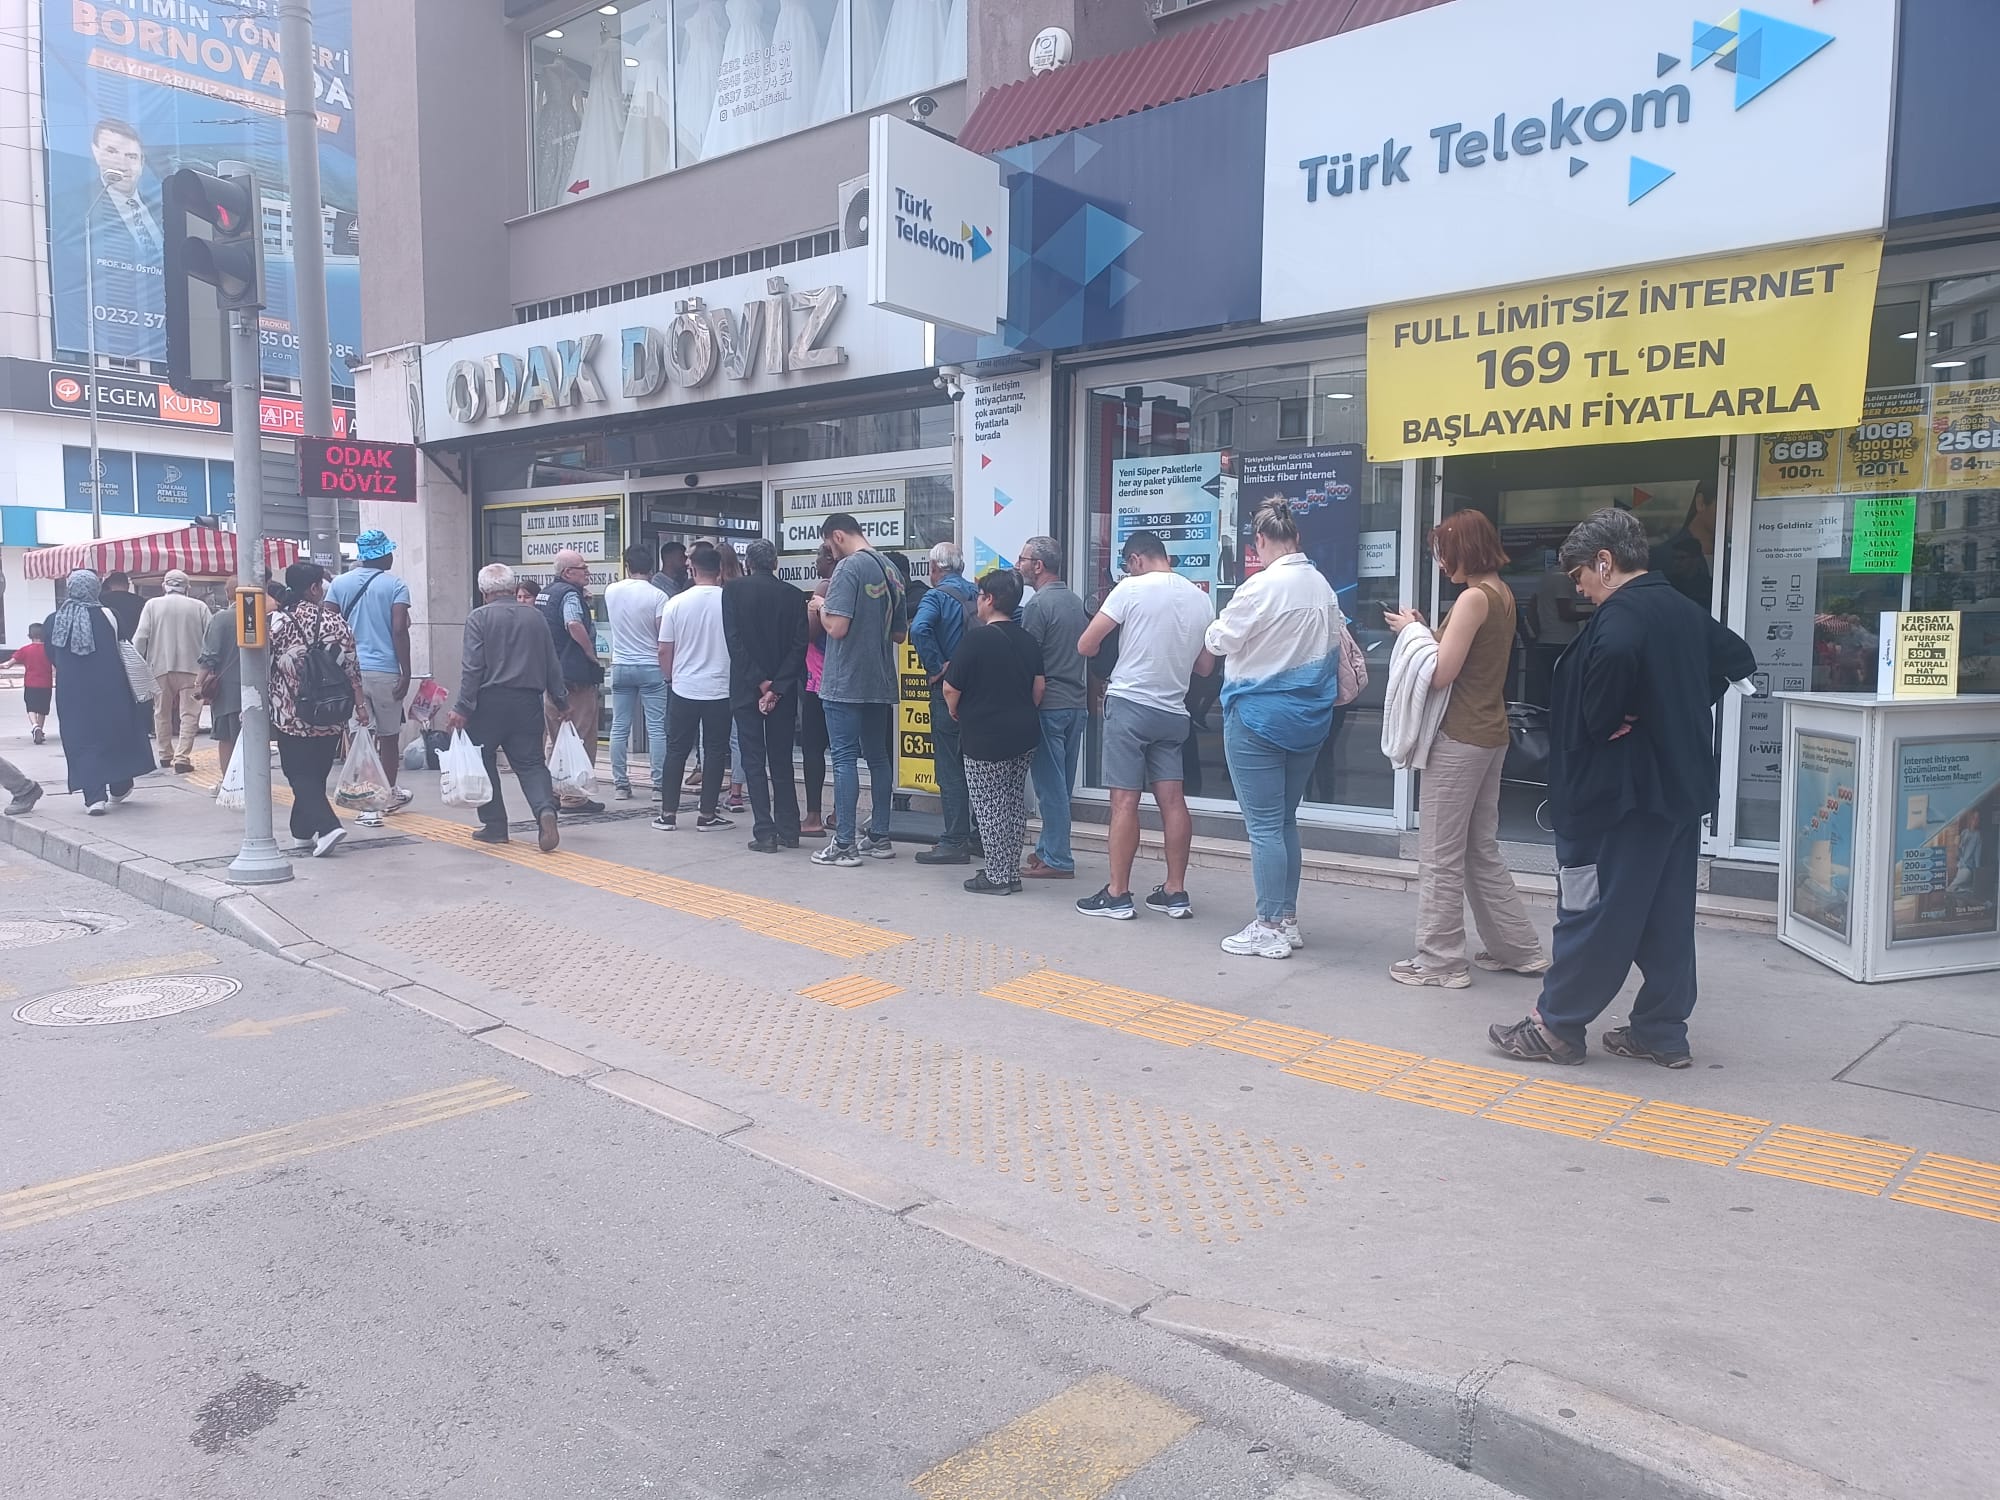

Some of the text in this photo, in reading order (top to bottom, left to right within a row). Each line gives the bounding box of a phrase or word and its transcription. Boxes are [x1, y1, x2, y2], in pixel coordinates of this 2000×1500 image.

[1299, 82, 1691, 203] Türk Telekom
[895, 187, 932, 222] Türk
[895, 215, 965, 260] Telekom
[96, 257, 119, 268] PROF.
[1394, 263, 1845, 348] FULL LİMİTSİZ İNTERNET
[93, 305, 166, 329] 0232 37
[446, 276, 850, 424] ODAK DÖVİZ
[1475, 340, 1571, 390] 169
[1583, 351, 1630, 379] TL
[975, 380, 1020, 394] Tüm iletişim
[163, 396, 215, 416] KURS
[975, 392, 1026, 406] ihtiyaçlarınız,
[975, 403, 1021, 420] çok avantajlı
[1403, 383, 1821, 448] BAŞLAYAN FİYATLARLA
[975, 416, 1009, 431] fiyatlarla
[1856, 421, 1913, 440] 10GB
[975, 430, 1001, 441] burada
[1774, 440, 1823, 460] 6GB
[1856, 438, 1913, 451] 1000 DK
[326, 447, 393, 469] ODAK
[1854, 449, 1913, 461] 250 SMS
[1119, 464, 1203, 478] Yeni Süper Paketlerle
[1244, 461, 1313, 474] hız tutkunlarına
[1856, 461, 1909, 477] 120TL
[321, 468, 397, 494] DÖVİZ
[1118, 479, 1131, 487] her
[1143, 477, 1166, 487] paket
[1167, 475, 1202, 486] yükleme
[1243, 470, 1337, 484] limitsiz fiber internet
[791, 488, 896, 510] ALTIN ALINIR SATILIR
[1118, 487, 1164, 497] derdine son
[527, 513, 599, 530] ALTIN ALINIR SATILIR
[1146, 515, 1159, 524] 30
[1159, 515, 1172, 524] GB
[1185, 513, 1205, 524] 240
[861, 520, 899, 537] FFICE
[1158, 530, 1171, 539] GB
[1185, 528, 1204, 539] 305
[1758, 521, 1814, 532] Hoş Geldiniz
[527, 540, 600, 556] CHANGE OFFICE
[1183, 556, 1203, 566] 420
[778, 565, 802, 581] ODAK
[1906, 615, 1950, 624] FIRSATI
[1766, 624, 1793, 641] 5G
[1901, 623, 1954, 633] KAÇIRMA
[1904, 634, 1950, 642] FATURASIZ
[1909, 649, 1931, 658] 390
[1905, 675, 1947, 685] BEDAVA
[1904, 775, 1921, 784] Türk
[1922, 773, 1952, 783] Telekom
[1905, 850, 1920, 858] 100
[1904, 862, 1920, 870] 200
[1903, 873, 1920, 882] 300
